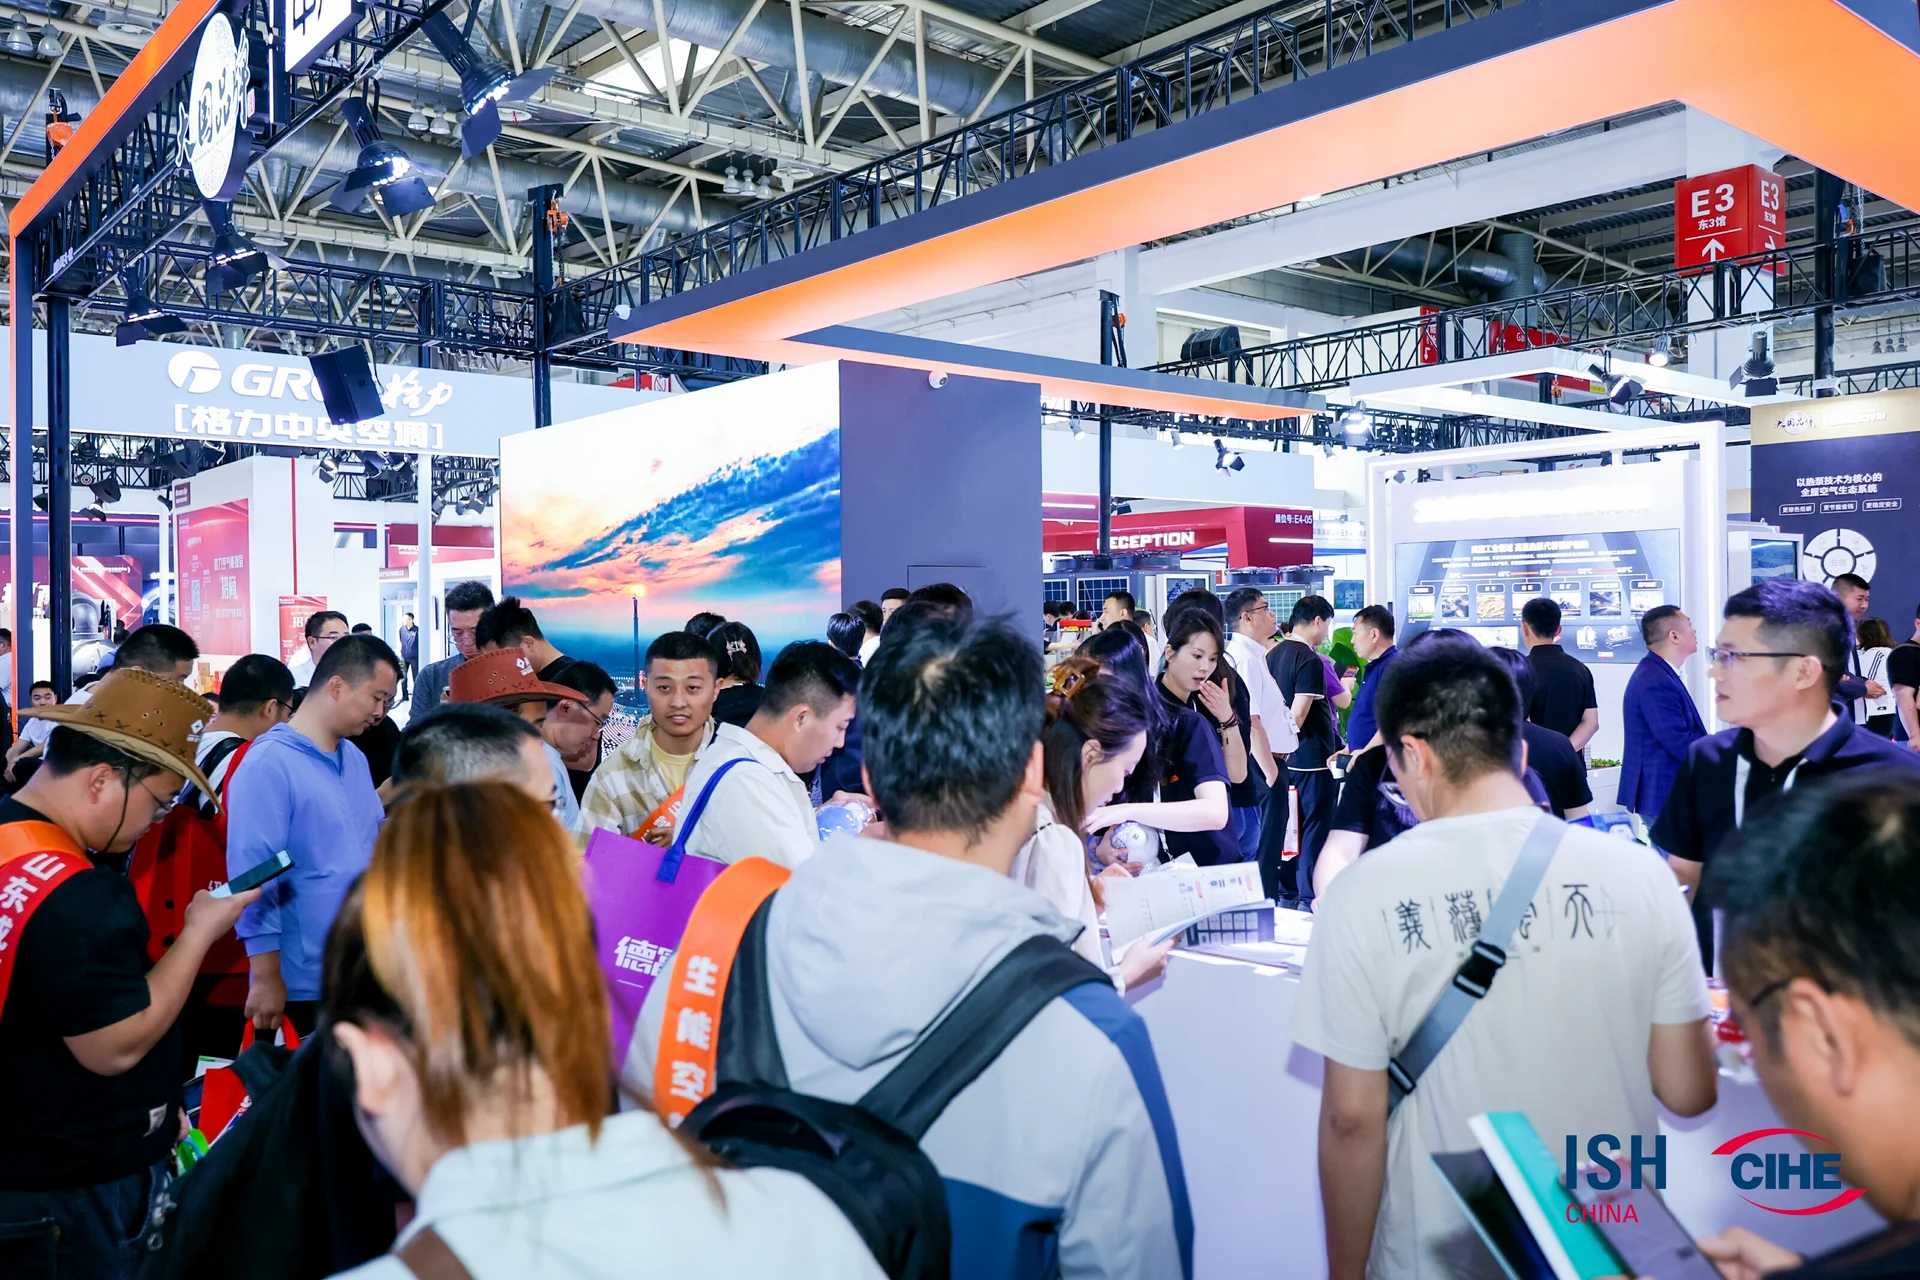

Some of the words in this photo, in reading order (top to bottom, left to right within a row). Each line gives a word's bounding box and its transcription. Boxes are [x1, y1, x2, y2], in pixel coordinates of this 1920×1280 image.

[1691, 184, 1735, 218] E3
[1761, 179, 1779, 211] E3
[1698, 216, 1727, 231] 东3馆
[1796, 472, 1883, 487] 以热泵技术为核心的
[1800, 483, 1878, 497] 全屋空气生态系统
[1097, 531, 1195, 550] ECEPTION
